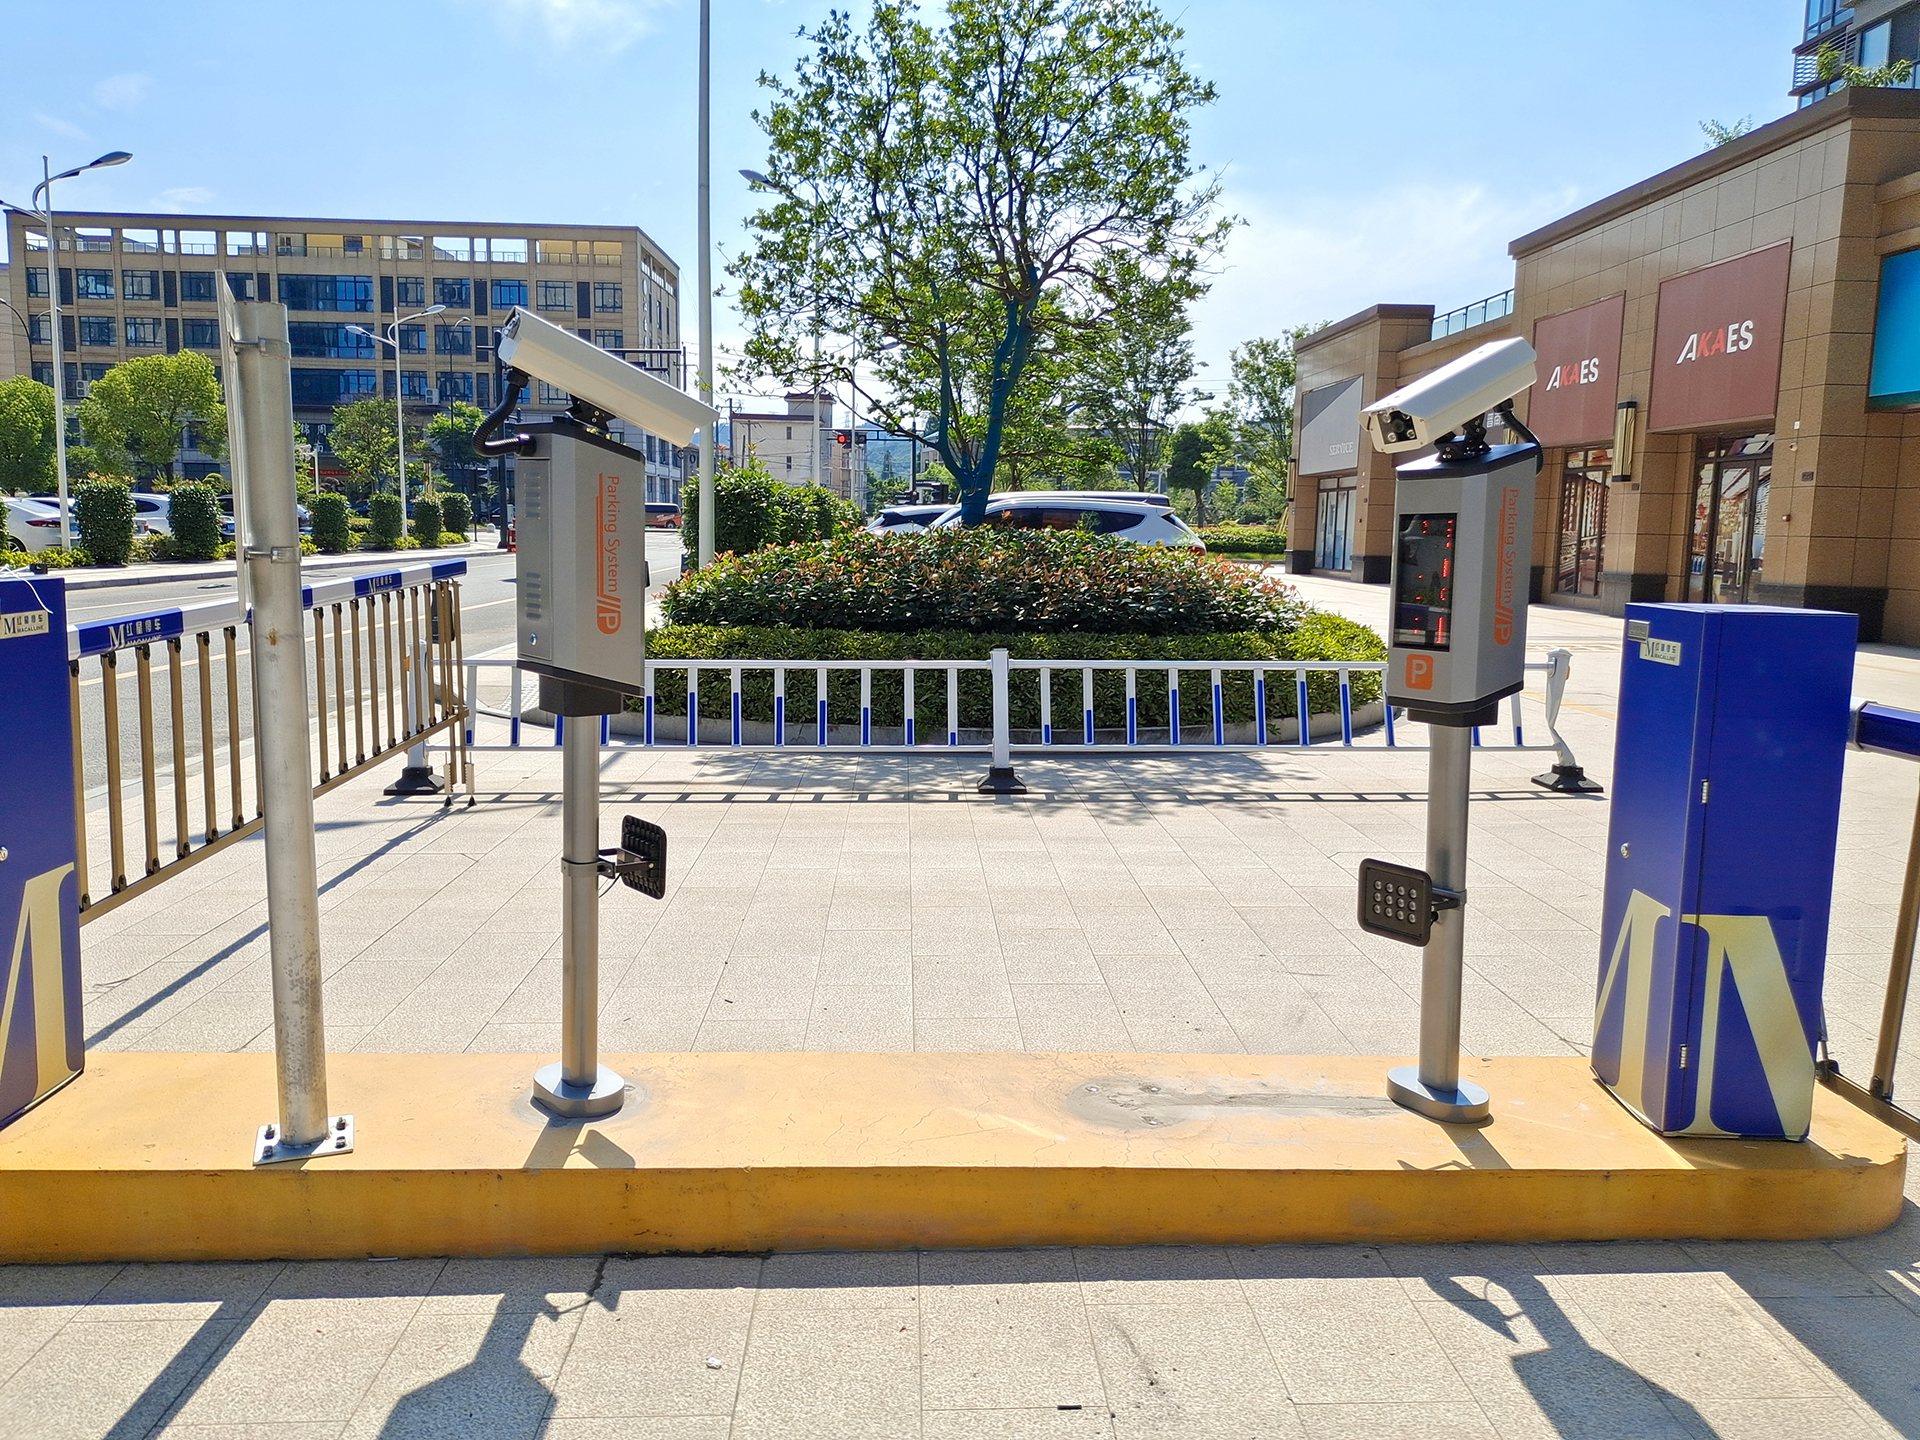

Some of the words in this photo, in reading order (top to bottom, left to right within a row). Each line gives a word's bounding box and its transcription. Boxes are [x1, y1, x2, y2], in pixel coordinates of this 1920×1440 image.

[1676, 320, 1754, 365] AKAES
[1545, 357, 1599, 391] AKAES
[1329, 441, 1354, 456] SERVICE
[604, 475, 620, 533] Parking
[1504, 489, 1519, 545] Parking
[604, 538, 621, 593] System
[1502, 550, 1516, 605] System
